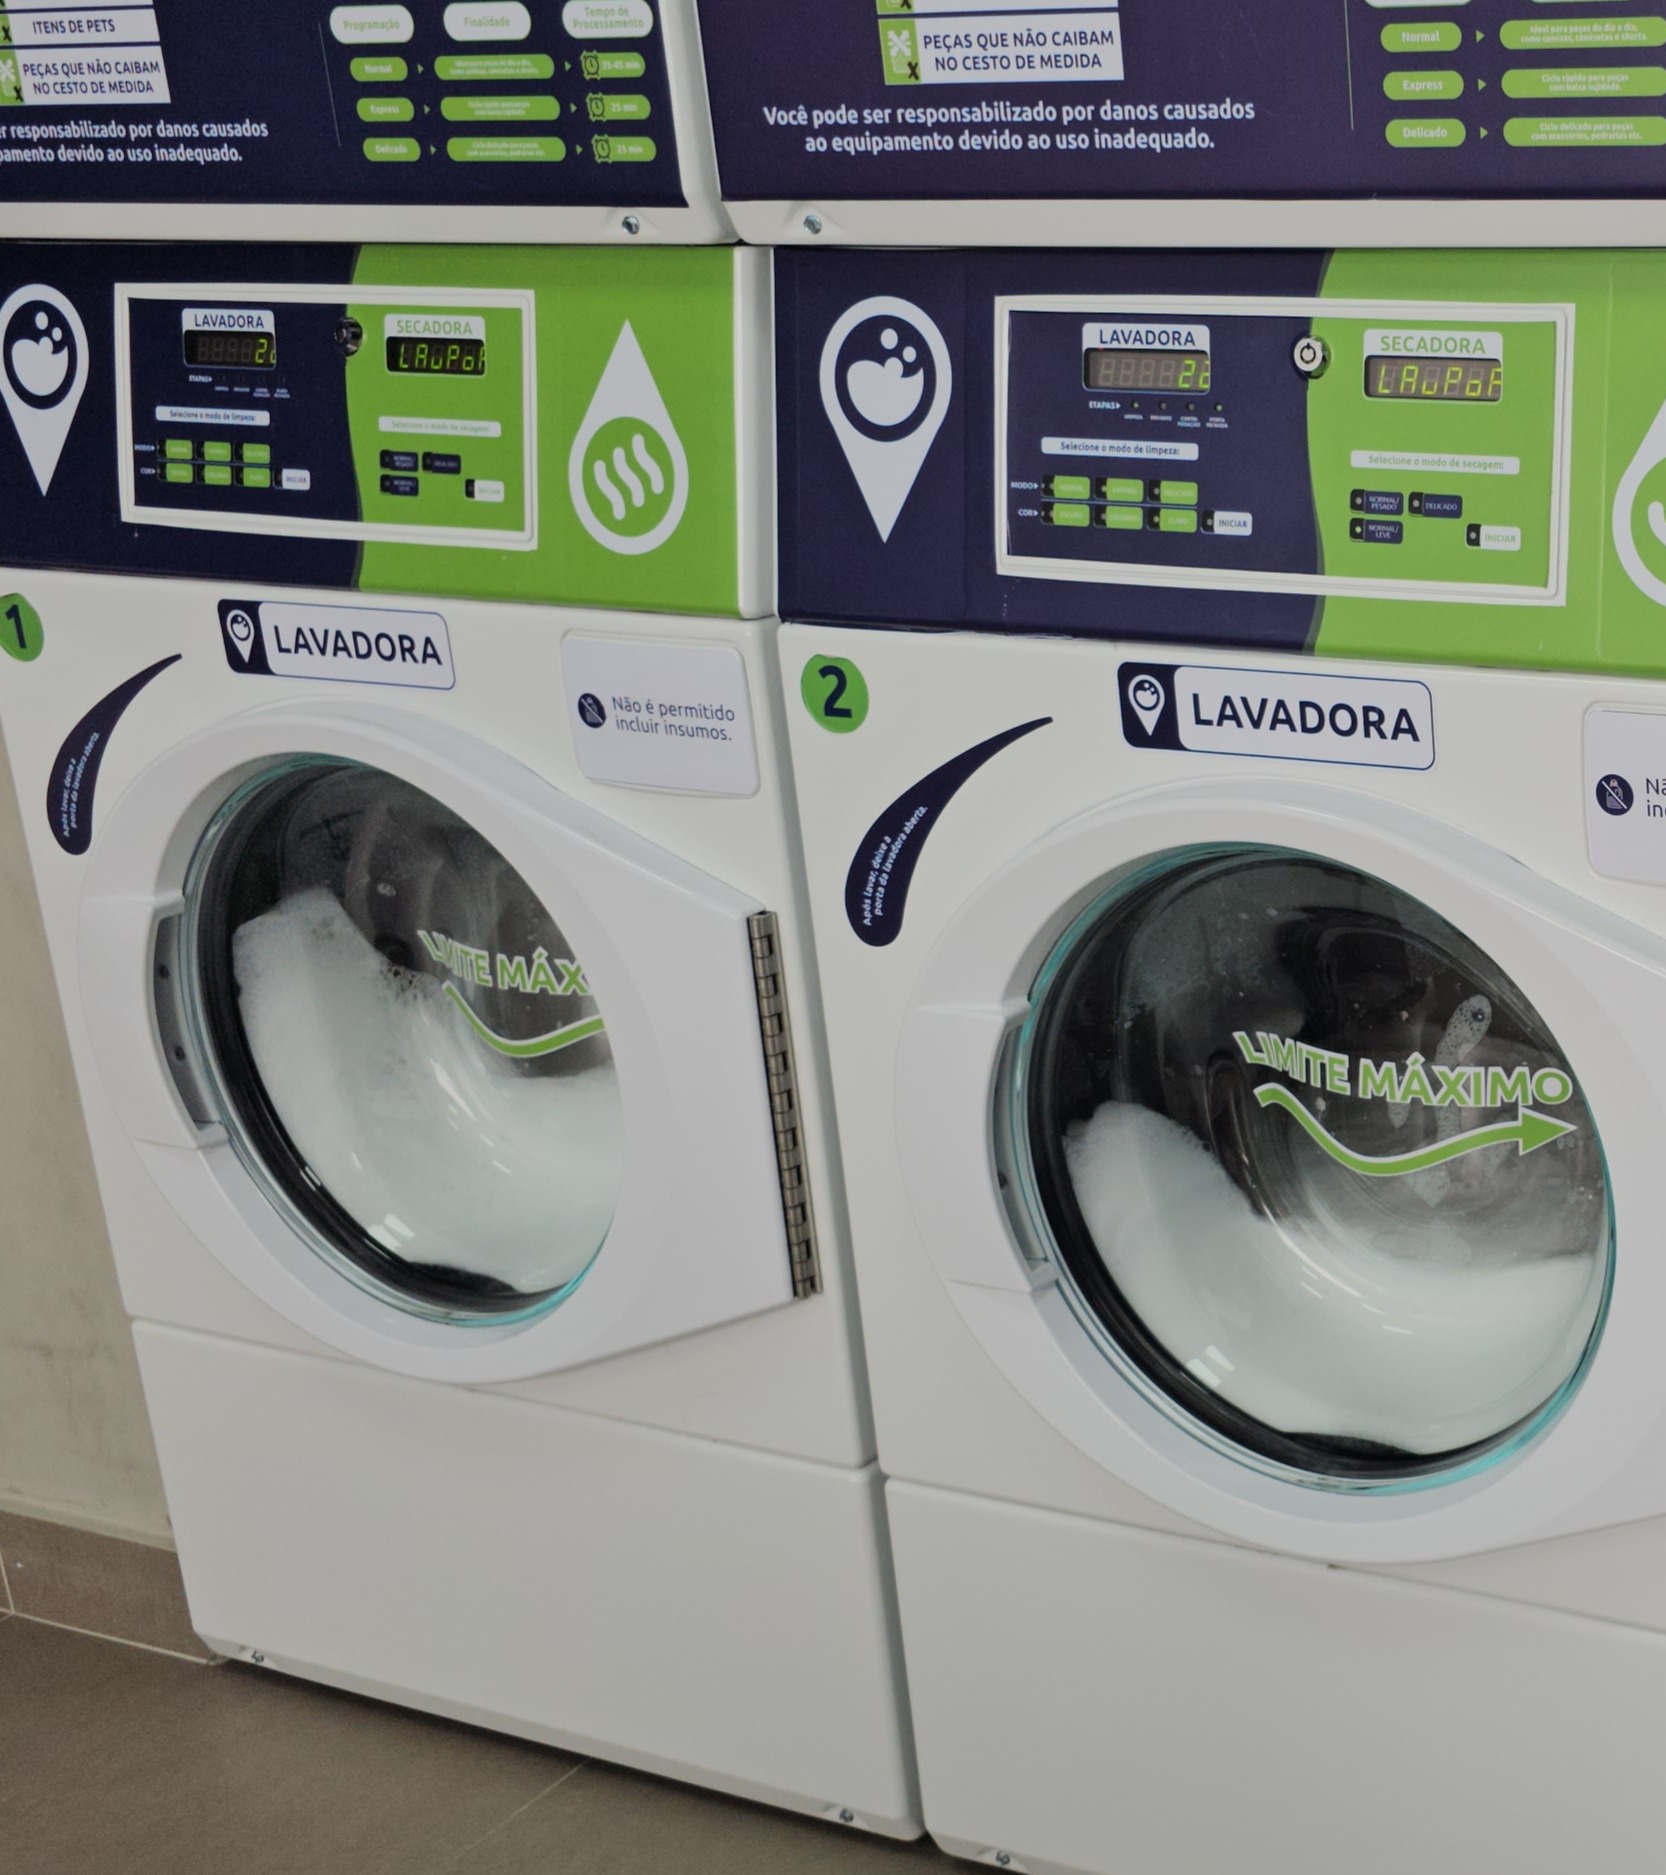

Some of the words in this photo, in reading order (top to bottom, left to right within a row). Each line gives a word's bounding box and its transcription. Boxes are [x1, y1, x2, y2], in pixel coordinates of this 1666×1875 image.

[584, 6, 615, 18] Tempo
[617, 6, 629, 16] de
[33, 20, 66, 34] ITENS
[69, 20, 84, 33] DE
[87, 19, 115, 32] PETS
[343, 19, 400, 31] Programação
[464, 16, 510, 27] Finalidade
[573, 17, 644, 29] Processamento
[923, 34, 972, 53] PEÇAS
[977, 33, 1009, 50] QUE
[1014, 29, 1047, 47] NÃO
[1051, 30, 1114, 46] CAIBAM
[1402, 31, 1440, 42] Normal
[23, 63, 58, 78] PEÇAS
[61, 62, 85, 77] QUE
[87, 59, 112, 75] NÃO
[115, 61, 160, 75] CAIBAM
[935, 57, 957, 71] NO
[962, 55, 1011, 70] CESTO
[1015, 55, 1037, 69] DE
[1040, 53, 1102, 68] MEDIDA
[33, 82, 50, 95] NO
[53, 82, 88, 94] CESTO
[91, 81, 106, 94] DE
[109, 80, 153, 93] MEDIDA
[1403, 79, 1443, 92] Express
[763, 105, 808, 125] Você
[813, 104, 858, 128] pode
[863, 109, 891, 124] ser
[897, 102, 1056, 127] responsabilizado
[1062, 105, 1094, 126] por
[1100, 100, 1159, 121] danos
[1164, 98, 1255, 120] causados
[11, 121, 126, 141] responsabilizado
[129, 125, 153, 141] por
[157, 120, 199, 137] danos
[202, 119, 268, 137] causados
[1403, 127, 1447, 139] Delicado
[805, 138, 827, 152] ao
[832, 133, 954, 155] equipamento
[959, 131, 1023, 150] devido
[1028, 134, 1051, 150] ao
[1056, 134, 1089, 149] uso
[1094, 128, 1214, 153] inadequado.
[58, 145, 104, 161] devido
[107, 149, 124, 161] ao
[128, 149, 152, 161] uso
[155, 143, 242, 164] inadequado.
[195, 313, 264, 329] LAVADORA
[397, 319, 473, 335] SECADORA
[1099, 329, 1196, 346] LAVADORA
[1380, 336, 1485, 354] SECADORA
[1089, 400, 1115, 409] ETAPAS
[1060, 441, 1099, 451] Selecione
[1109, 444, 1131, 453] modo
[1134, 445, 1143, 454] de
[1011, 482, 1034, 490] MODO
[1018, 509, 1034, 517] COR
[1219, 519, 1248, 528] INICIAR
[1485, 534, 1516, 543] INICIAR
[5, 605, 27, 649] 1
[273, 624, 443, 665] LAVADORA
[818, 666, 852, 718] 2
[612, 696, 642, 714] Não
[646, 699, 654, 714] é
[659, 703, 735, 722] permitido
[1192, 693, 1420, 742] LAVADORA
[615, 716, 660, 734] incluir
[664, 720, 733, 741] insumos.
[417, 929, 493, 988] LIMITE
[496, 946, 592, 996] MÁX
[1232, 1030, 1351, 1096] LIMITE
[1358, 1051, 1573, 1107] MÁXIMO
